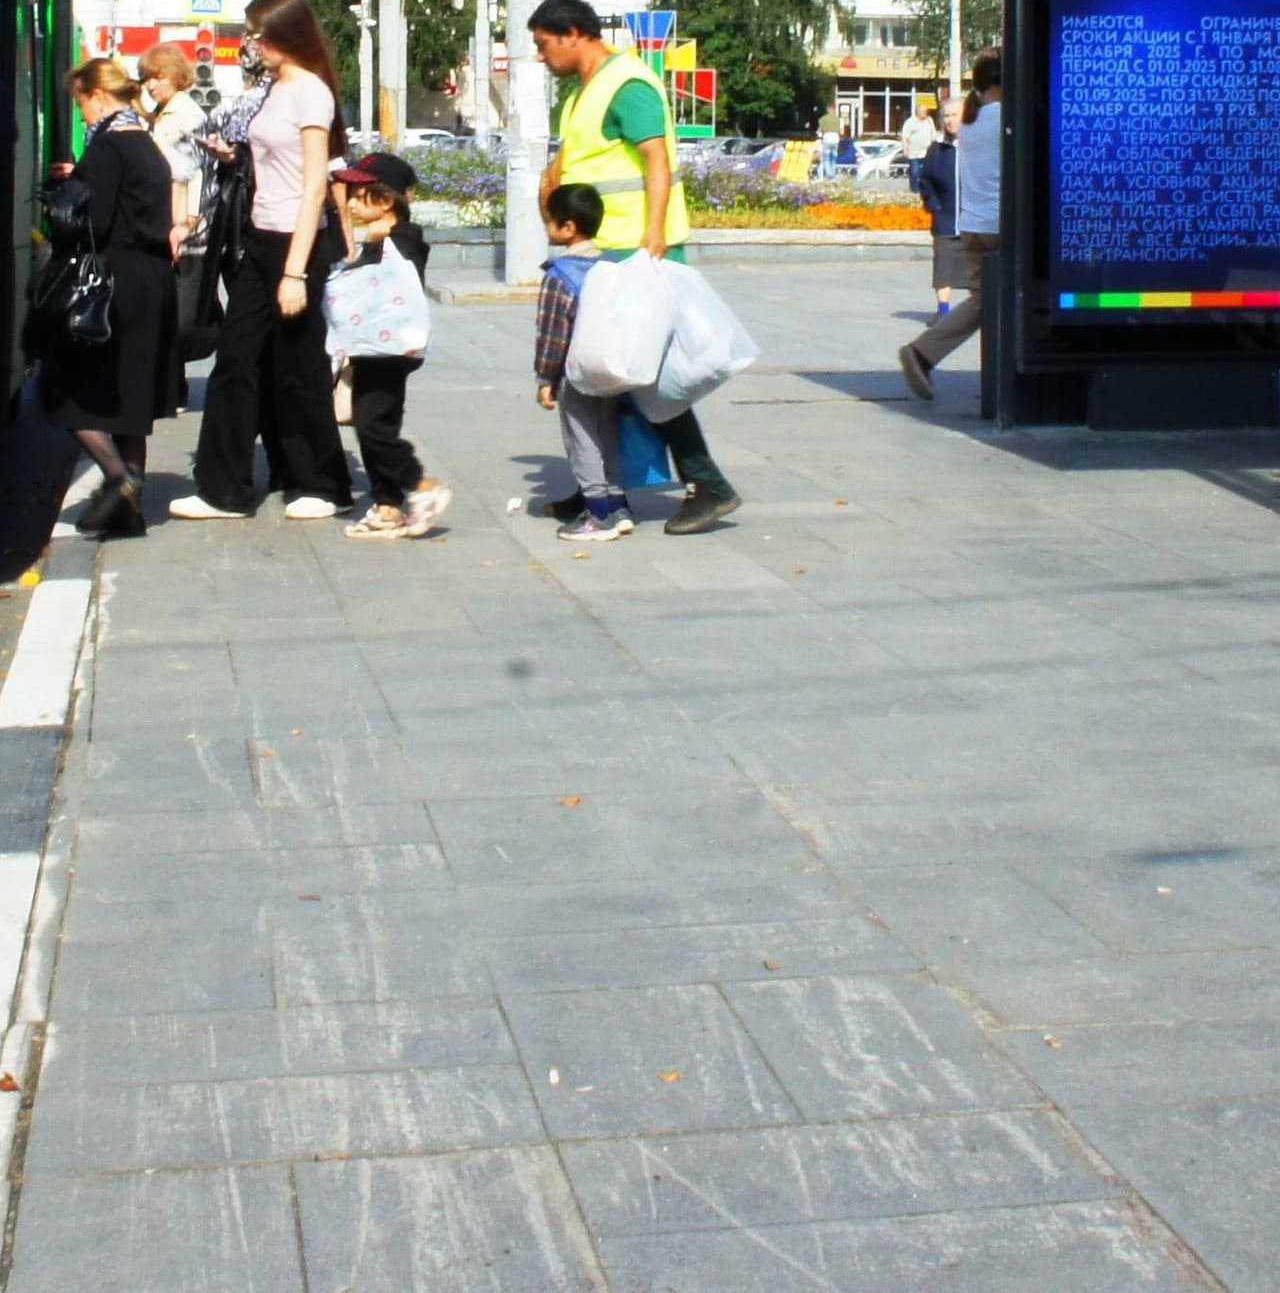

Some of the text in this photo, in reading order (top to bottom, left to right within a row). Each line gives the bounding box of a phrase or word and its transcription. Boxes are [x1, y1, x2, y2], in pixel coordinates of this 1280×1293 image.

[1061, 15, 1144, 28] ИМЕЮТСЯ
[1061, 31, 1117, 44] СРОКИ
[1122, 31, 1180, 44] АКЦИИ
[1184, 31, 1197, 44] С
[1201, 31, 1206, 44] 1
[1211, 31, 1272, 44] ЯНВАРЯ
[1060, 45, 1133, 58] ДЕКАБРЯ
[1147, 45, 1181, 58] 2025
[1219, 45, 1243, 58] ПО
[1062, 59, 1129, 72] ПЕРИОД
[1134, 59, 1144, 72] С
[1148, 59, 1216, 72] 01.01.2025
[1221, 59, 1245, 72] ПО
[1062, 74, 1086, 87] ПО
[1089, 74, 1127, 87] МСК
[1128, 74, 1191, 87] РАЗМЕР
[1191, 74, 1258, 87] СКИДКИ
[1271, 74, 1280, 87] 4
[1061, 88, 1072, 101] С
[1074, 88, 1146, 101] 01.09.2025
[1162, 88, 1185, 101] ПО
[1189, 88, 1255, 101] 31.12.2025
[1258, 88, 1280, 101] ПО
[1062, 103, 1123, 116] РАЗМЕР
[1128, 103, 1196, 116] СКИДКИ
[1215, 103, 1223, 116] 9
